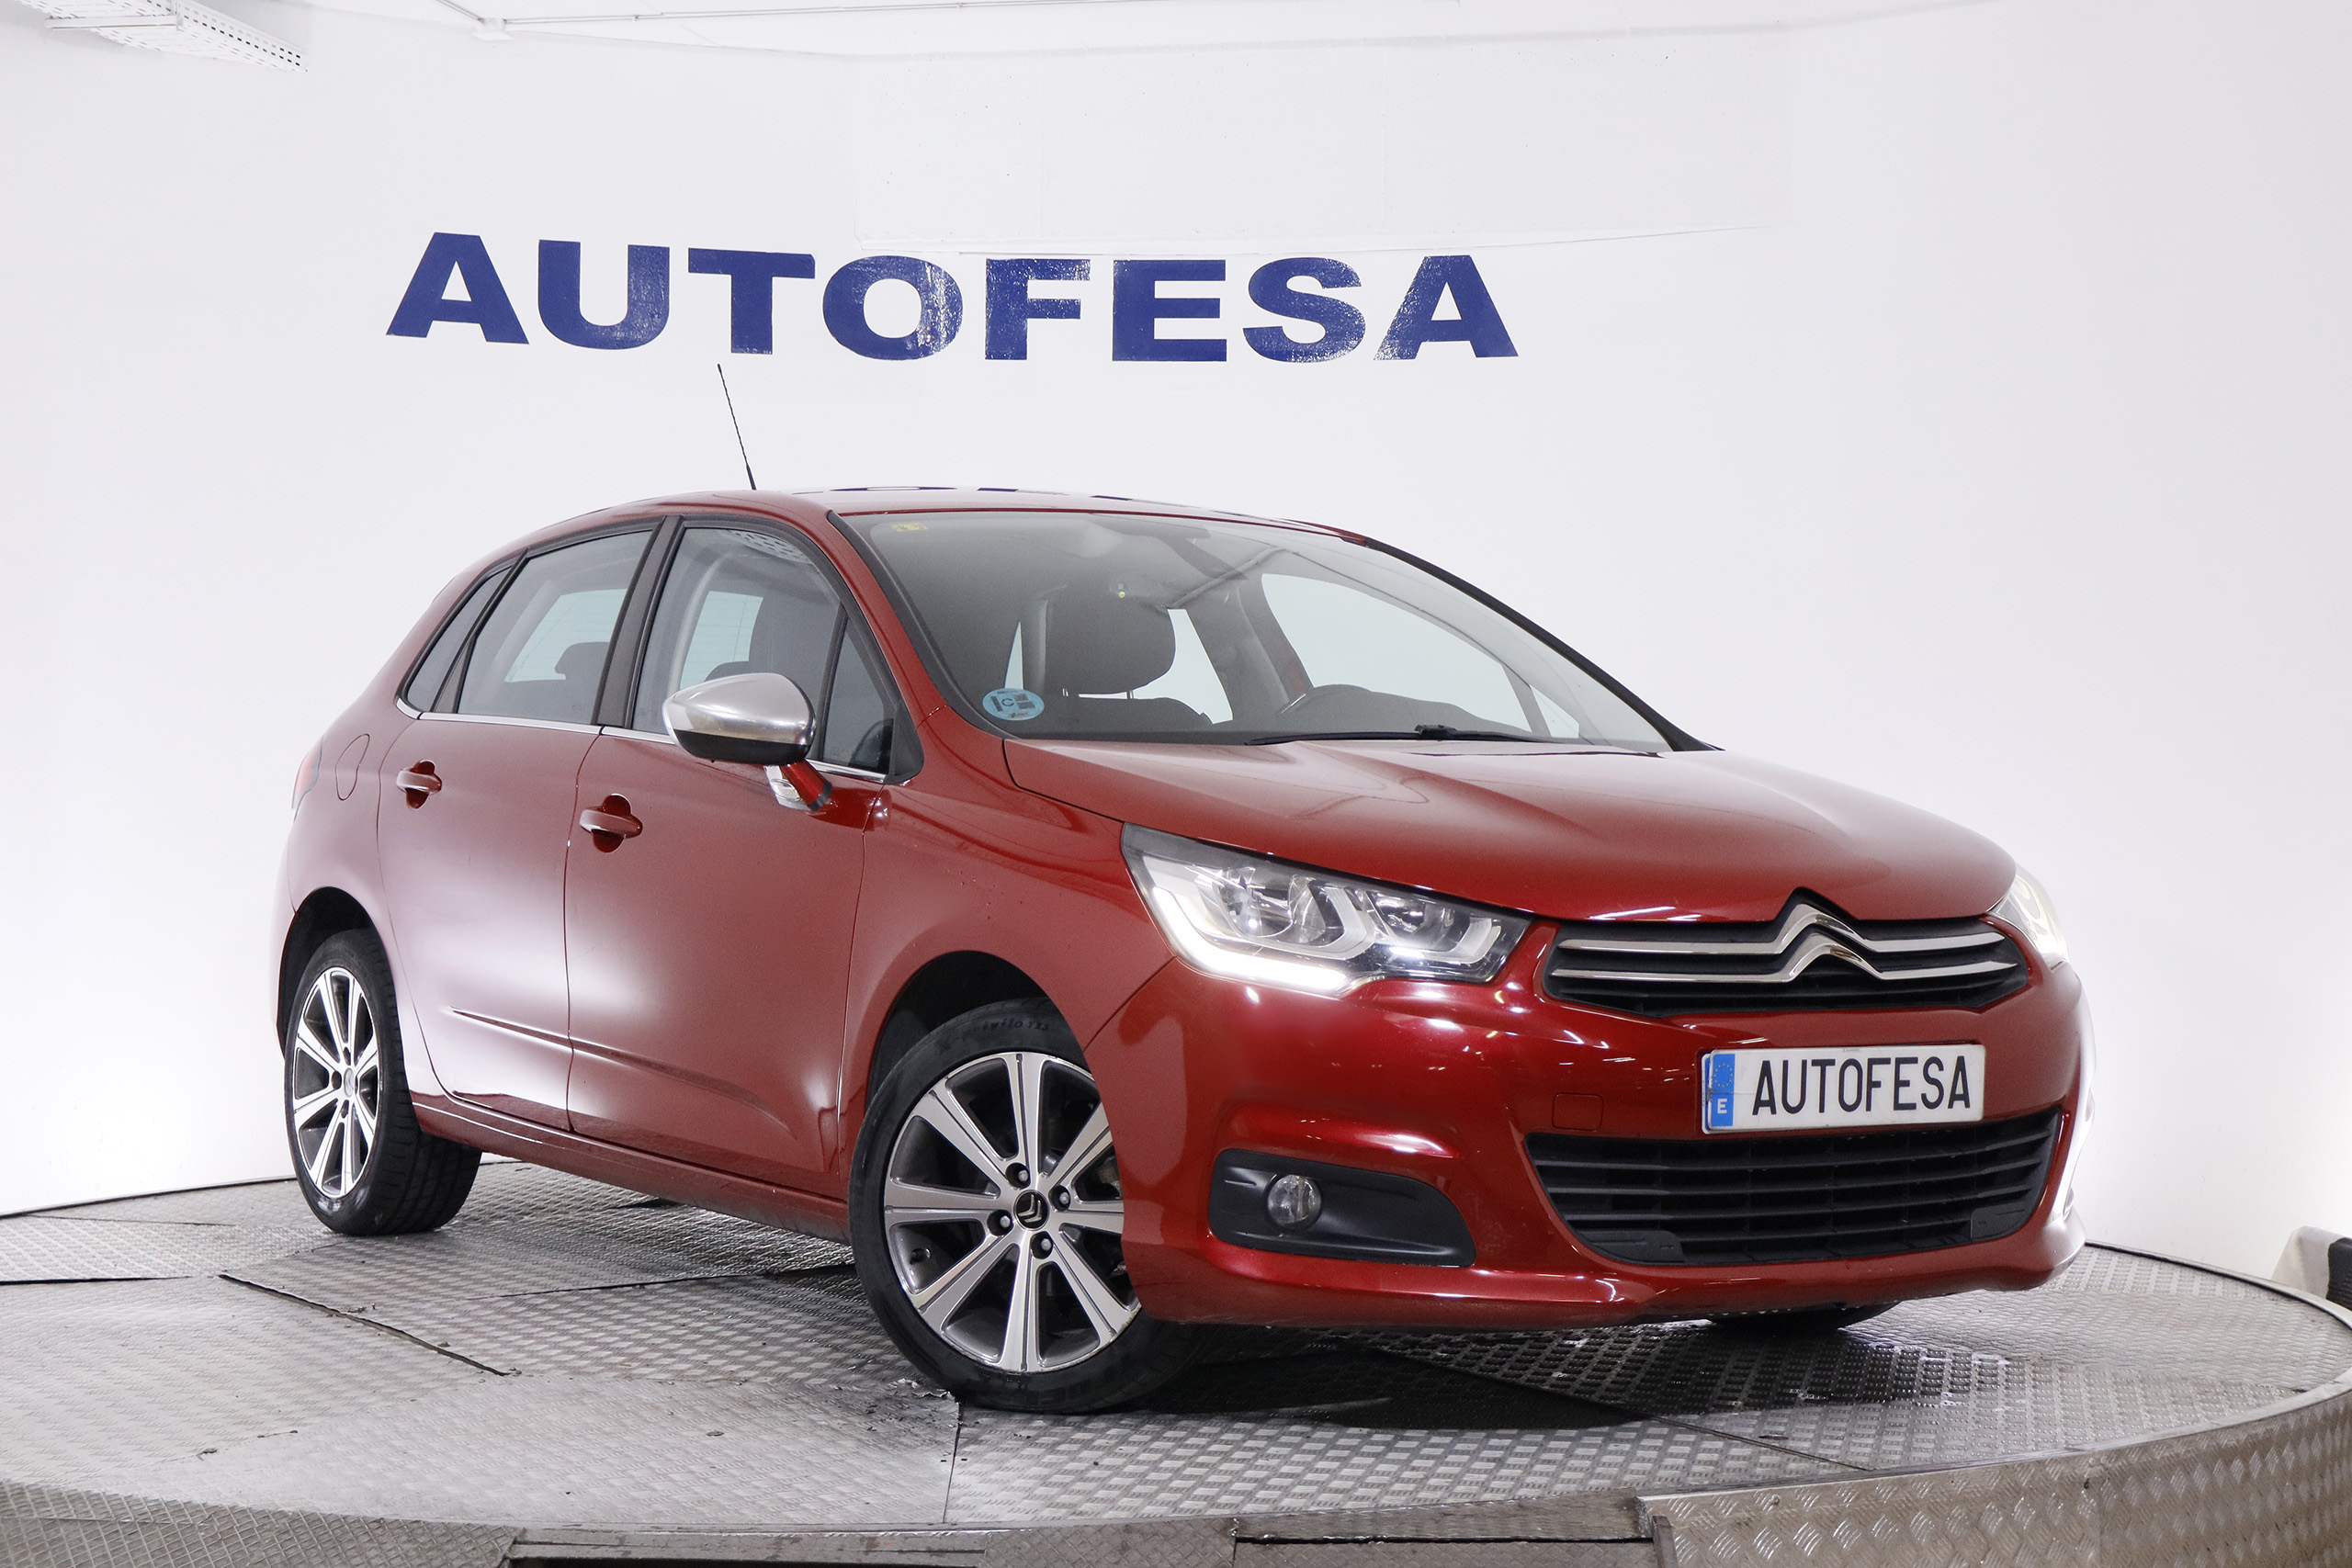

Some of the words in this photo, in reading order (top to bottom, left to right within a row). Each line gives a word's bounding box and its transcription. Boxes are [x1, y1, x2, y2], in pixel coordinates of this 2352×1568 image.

[386, 232, 1519, 363] AUTOFESA
[1717, 1098, 1728, 1114] E
[1752, 1055, 1971, 1116] AUTOFESA
